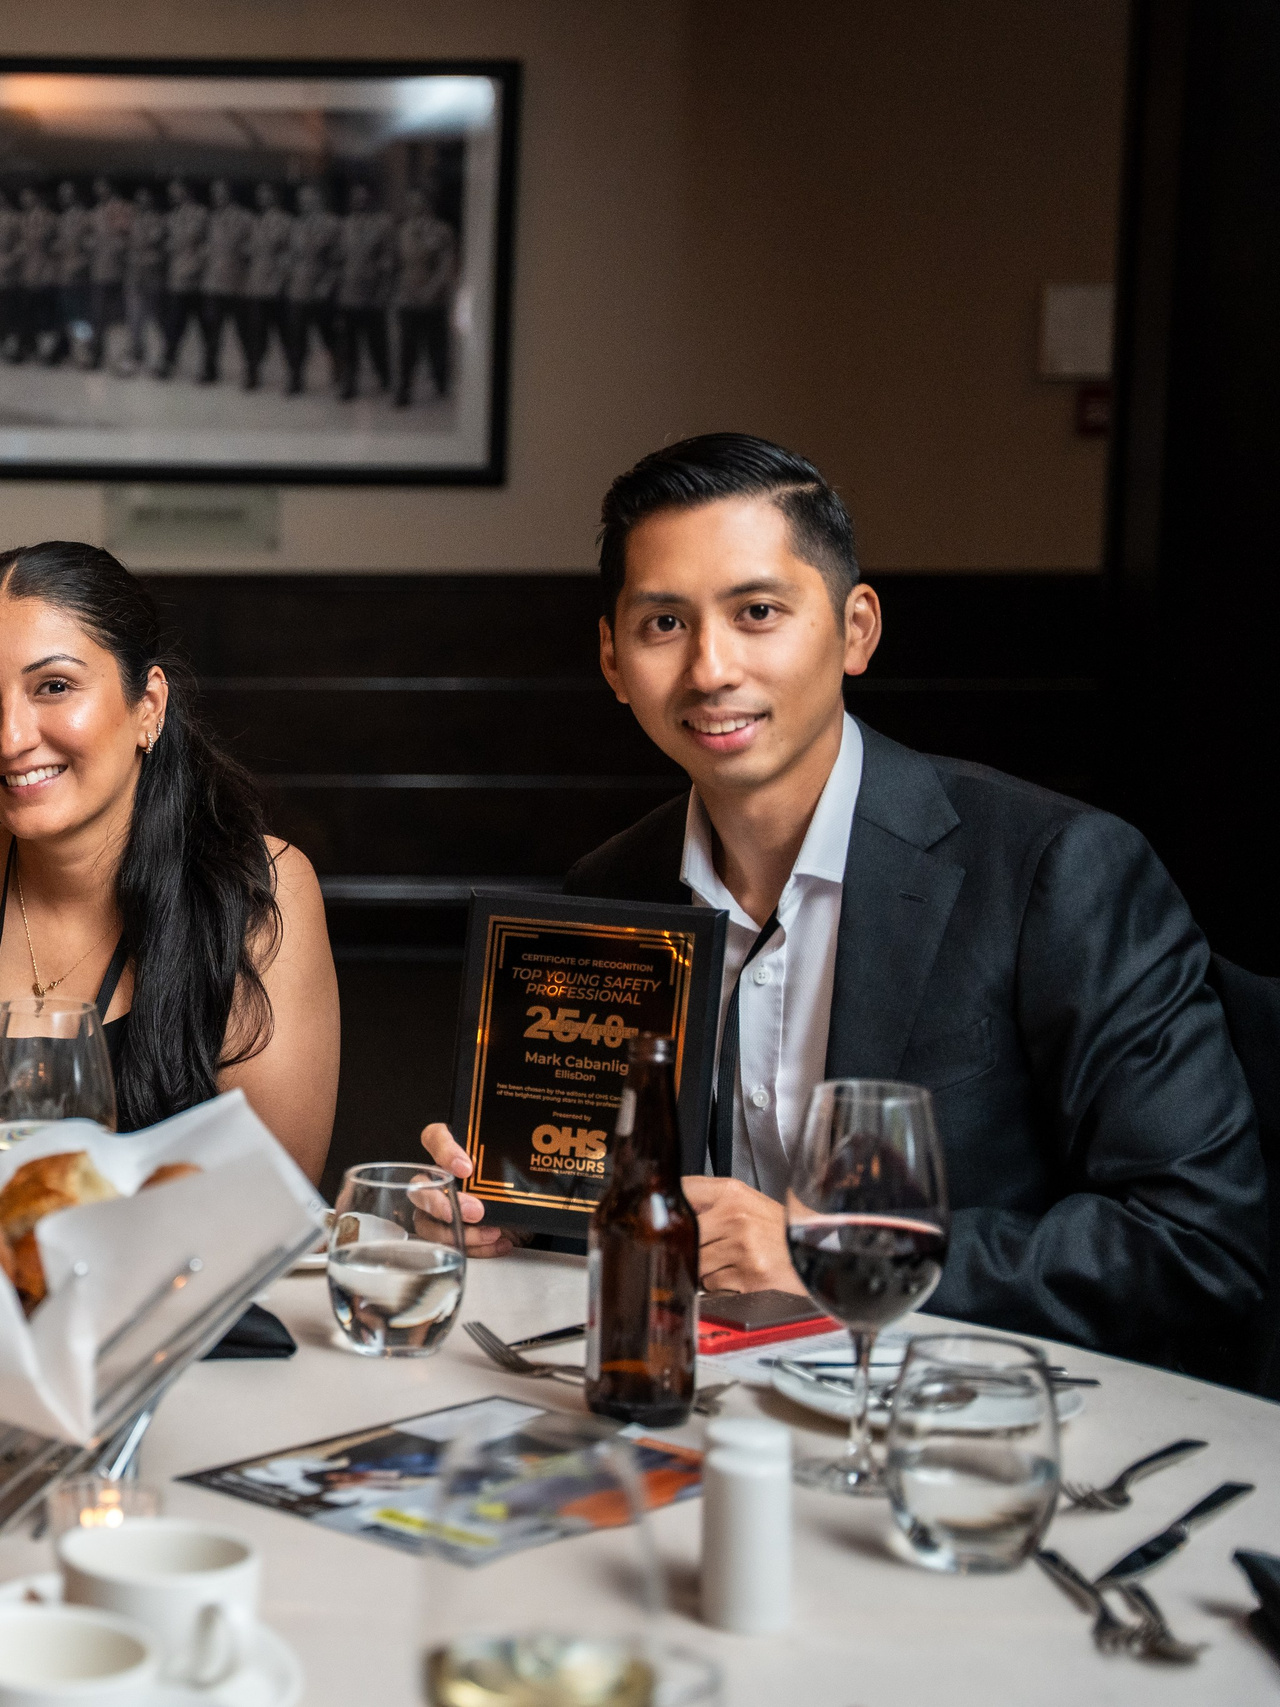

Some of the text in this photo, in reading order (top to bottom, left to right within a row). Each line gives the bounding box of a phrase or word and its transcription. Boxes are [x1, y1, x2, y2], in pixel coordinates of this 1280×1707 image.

[521, 953, 576, 965] CERTIFICATE
[592, 960, 653, 971] RECOGNITION
[512, 967, 661, 991] TOP YOUNG SAFETY
[526, 983, 640, 1004] PROFESSIONAL
[525, 1051, 629, 1076] Mark Cabanlig
[555, 1069, 596, 1081] EllisDon
[552, 1111, 583, 1120] Presented
[532, 1124, 607, 1160] OHS
[530, 1154, 605, 1173] HONOURS
